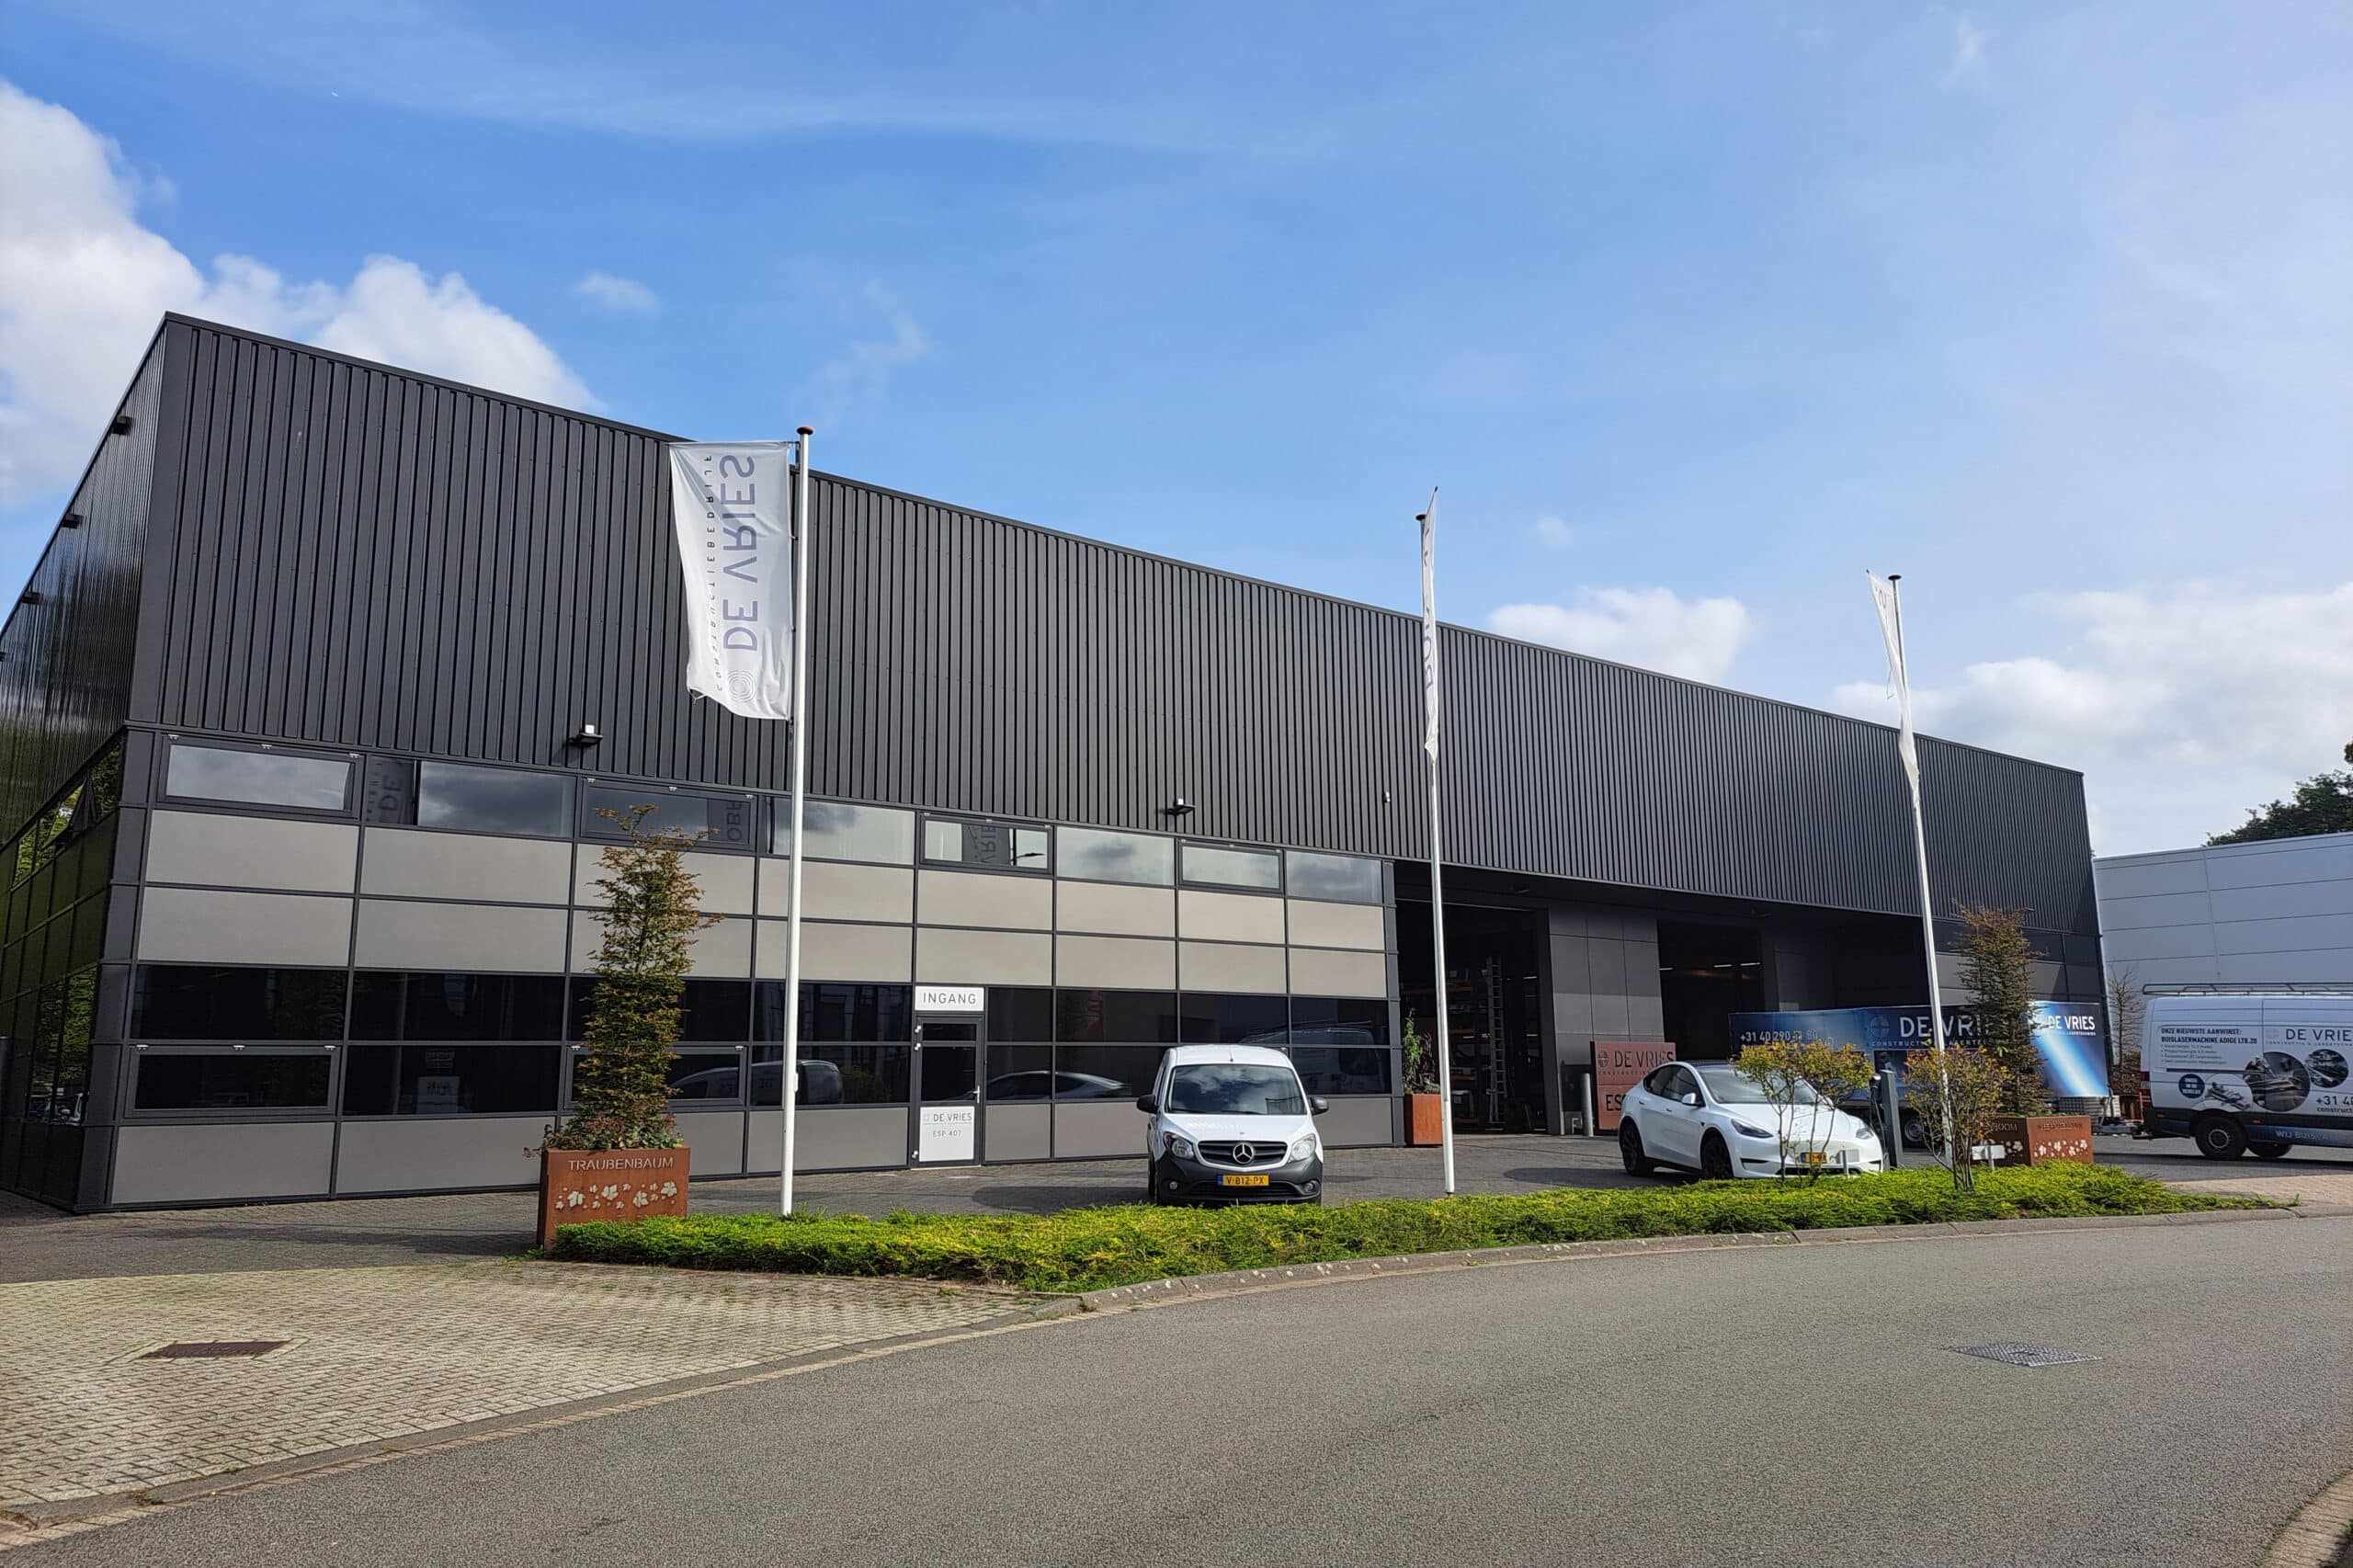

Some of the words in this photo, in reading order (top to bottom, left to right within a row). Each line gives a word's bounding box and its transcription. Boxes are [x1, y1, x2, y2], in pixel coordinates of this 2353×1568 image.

[923, 993, 977, 1005] INGANG
[1899, 1016, 1931, 1038] DE
[2048, 1015, 2063, 1029] DE
[2063, 1015, 2096, 1030] VRIES
[1740, 1031, 1756, 1042] +31
[1759, 1031, 1770, 1041] 40
[1773, 1030, 1790, 1041] 290
[2161, 1036, 2218, 1044] BUISLASERMACHINE
[2285, 1028, 2307, 1040] DE
[1614, 1051, 1632, 1068] DE
[1636, 1051, 1675, 1068] VRIES
[2316, 1095, 2338, 1106] +31
[933, 1113, 945, 1122] DE
[948, 1112, 972, 1121] VRIES
[933, 1130, 947, 1138] ESP
[567, 1156, 674, 1171] TRAUBENBAUM
[1226, 1176, 1265, 1186] V-812-PX
